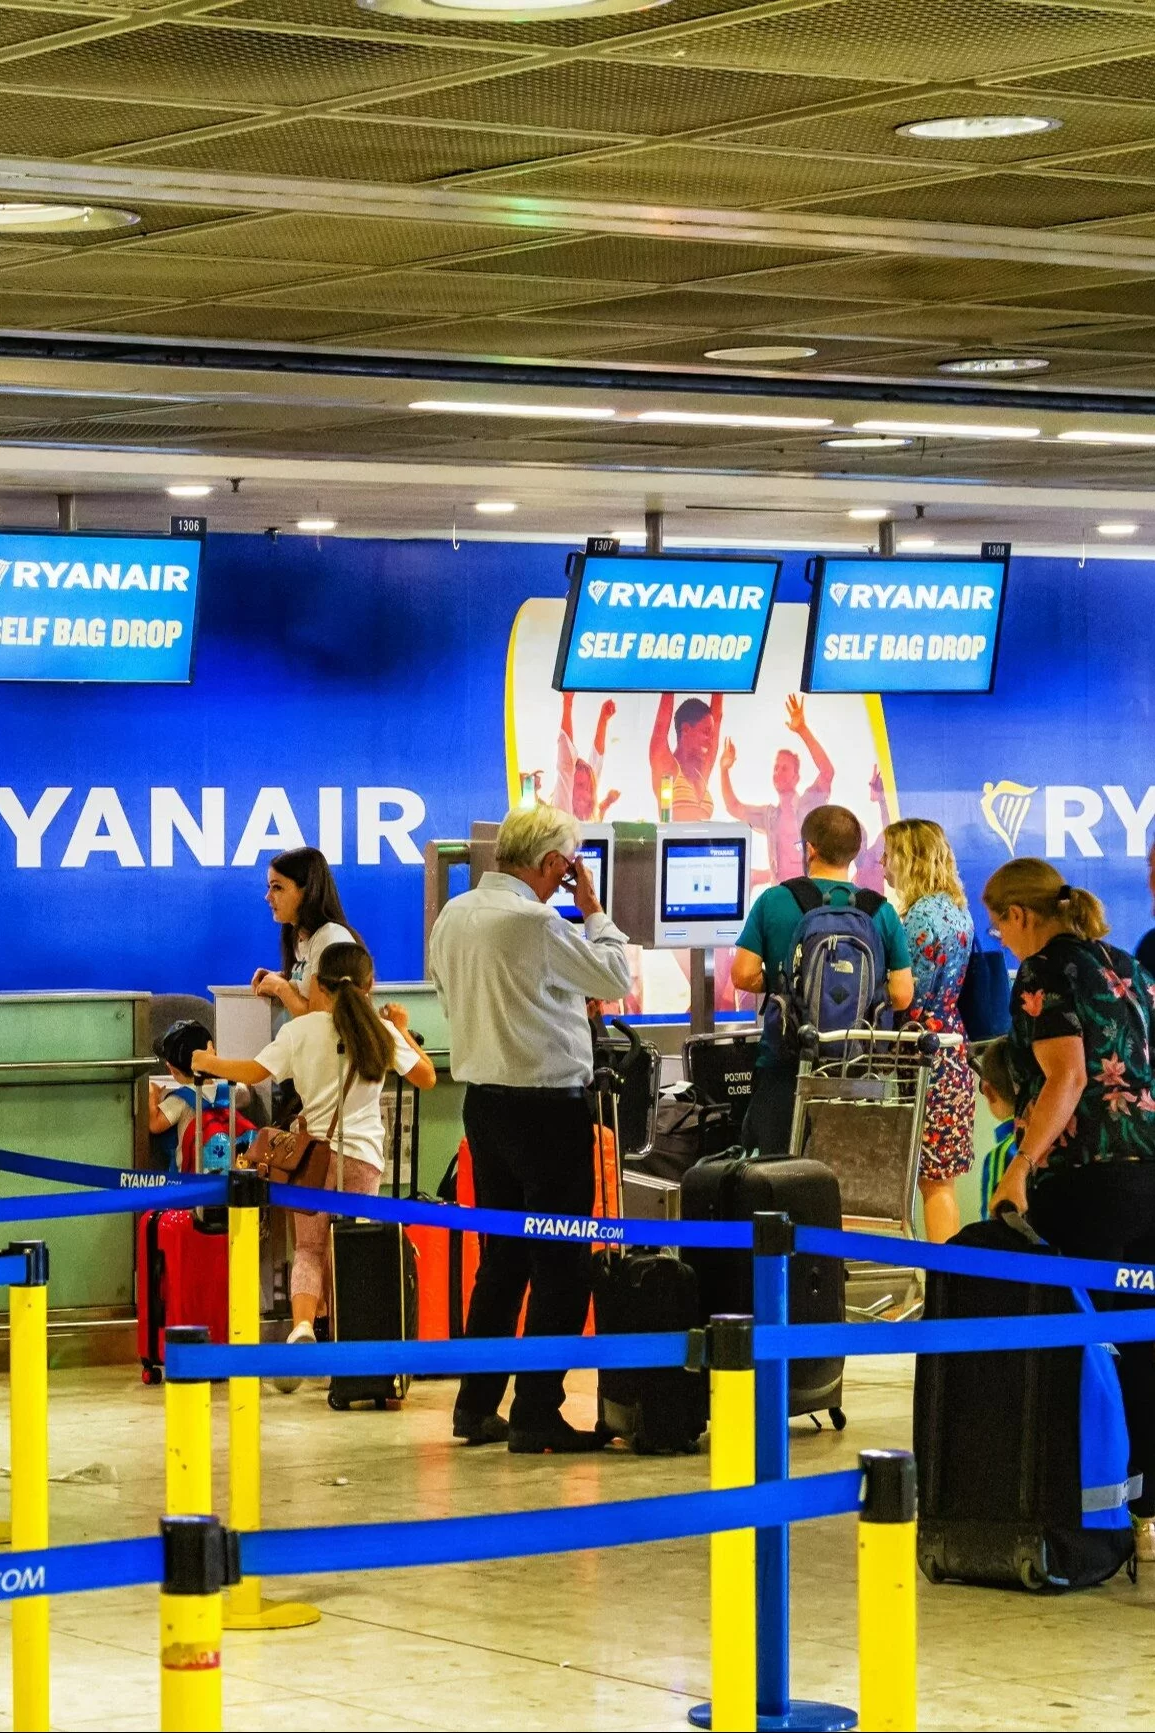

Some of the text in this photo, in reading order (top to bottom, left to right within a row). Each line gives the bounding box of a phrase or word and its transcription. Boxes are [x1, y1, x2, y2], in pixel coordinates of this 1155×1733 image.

[178, 520, 200, 532] 1306
[593, 540, 613, 551] 1307
[987, 545, 1005, 556] 1308
[13, 561, 190, 592] RYANAIR
[609, 582, 764, 610] RYANAIR
[849, 584, 995, 610] RYANAIR
[53, 618, 106, 647] BAG
[111, 620, 183, 648] DROP
[578, 632, 752, 660] SELF BAG DROP
[823, 634, 987, 661] SELF BAG DROP
[1045, 785, 1155, 858] RY
[725, 1071, 752, 1082] POSITIO
[524, 1217, 624, 1239] RYANAIR.COM
[1115, 1268, 1155, 1290] RYA
